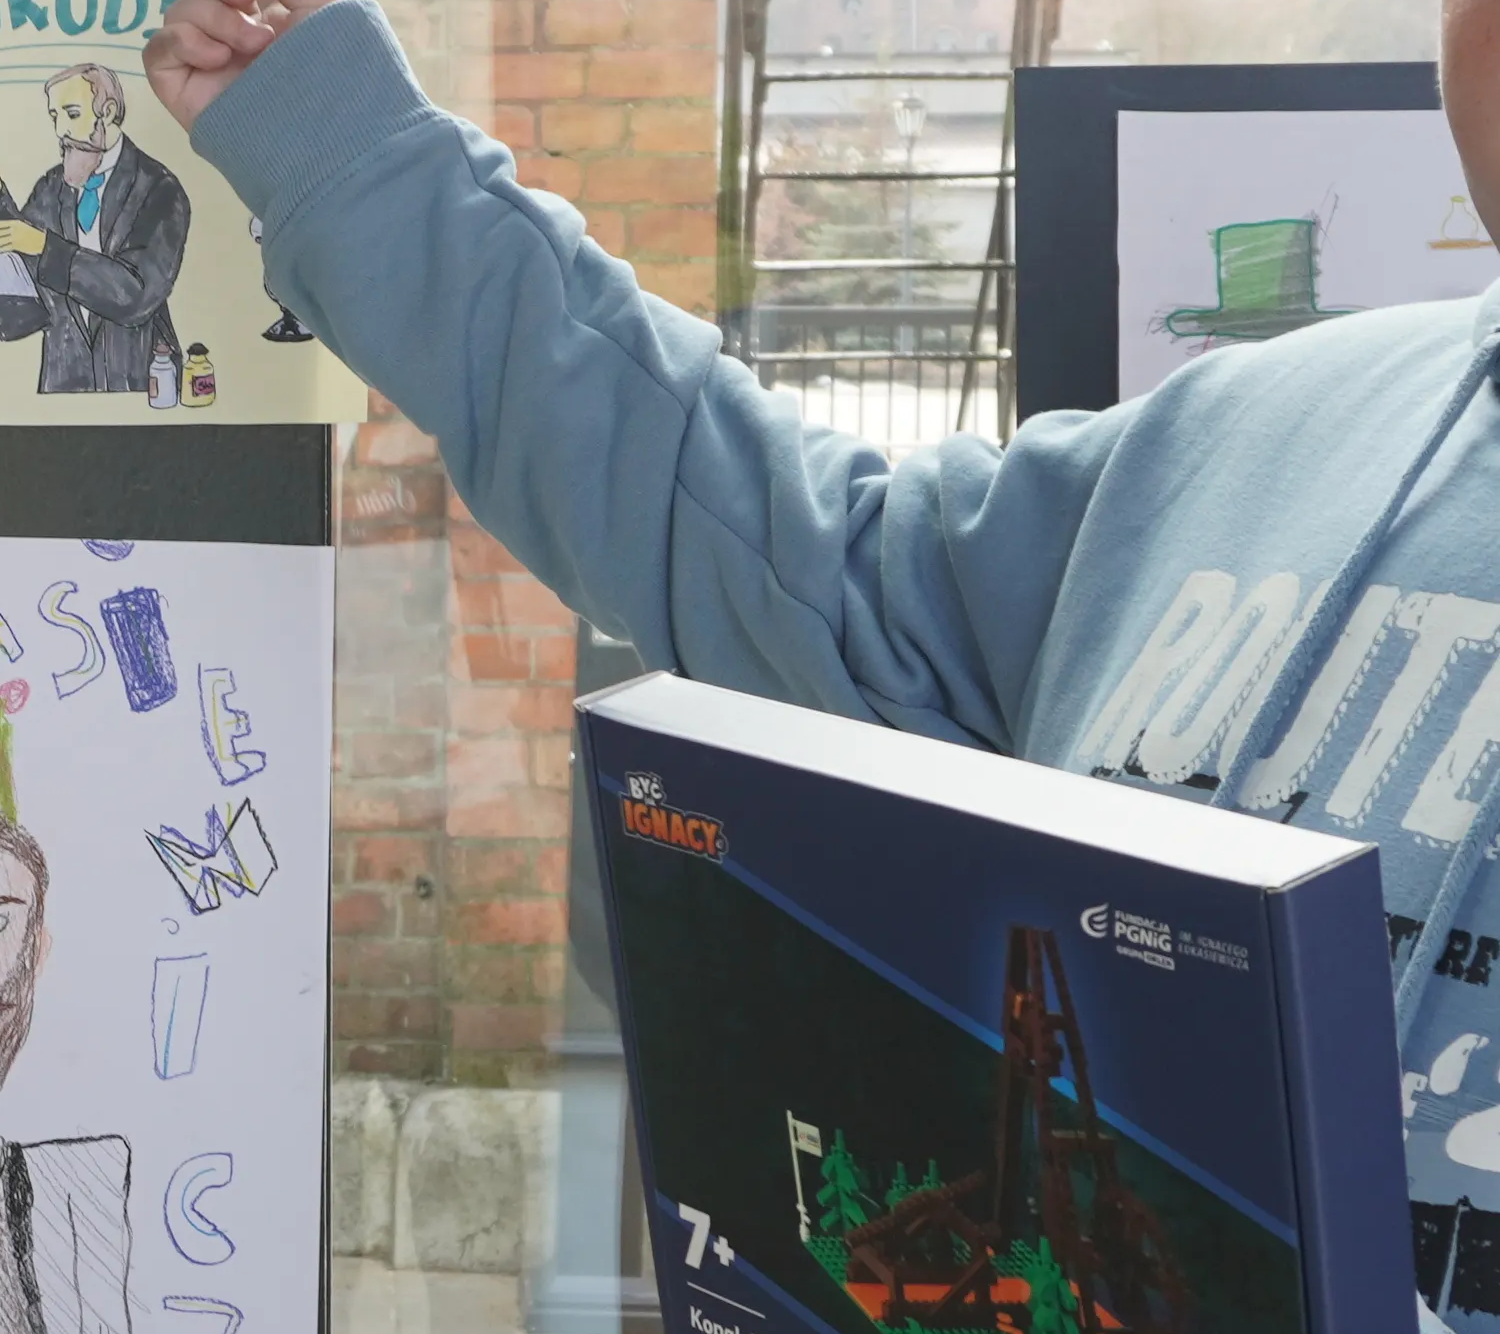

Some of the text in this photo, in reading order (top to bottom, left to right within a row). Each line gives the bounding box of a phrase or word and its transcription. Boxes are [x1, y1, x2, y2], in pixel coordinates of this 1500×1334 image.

[623, 799, 718, 855] IGNACY
[1114, 922, 1173, 953] PGNiG
[678, 1202, 736, 1270] 7+
